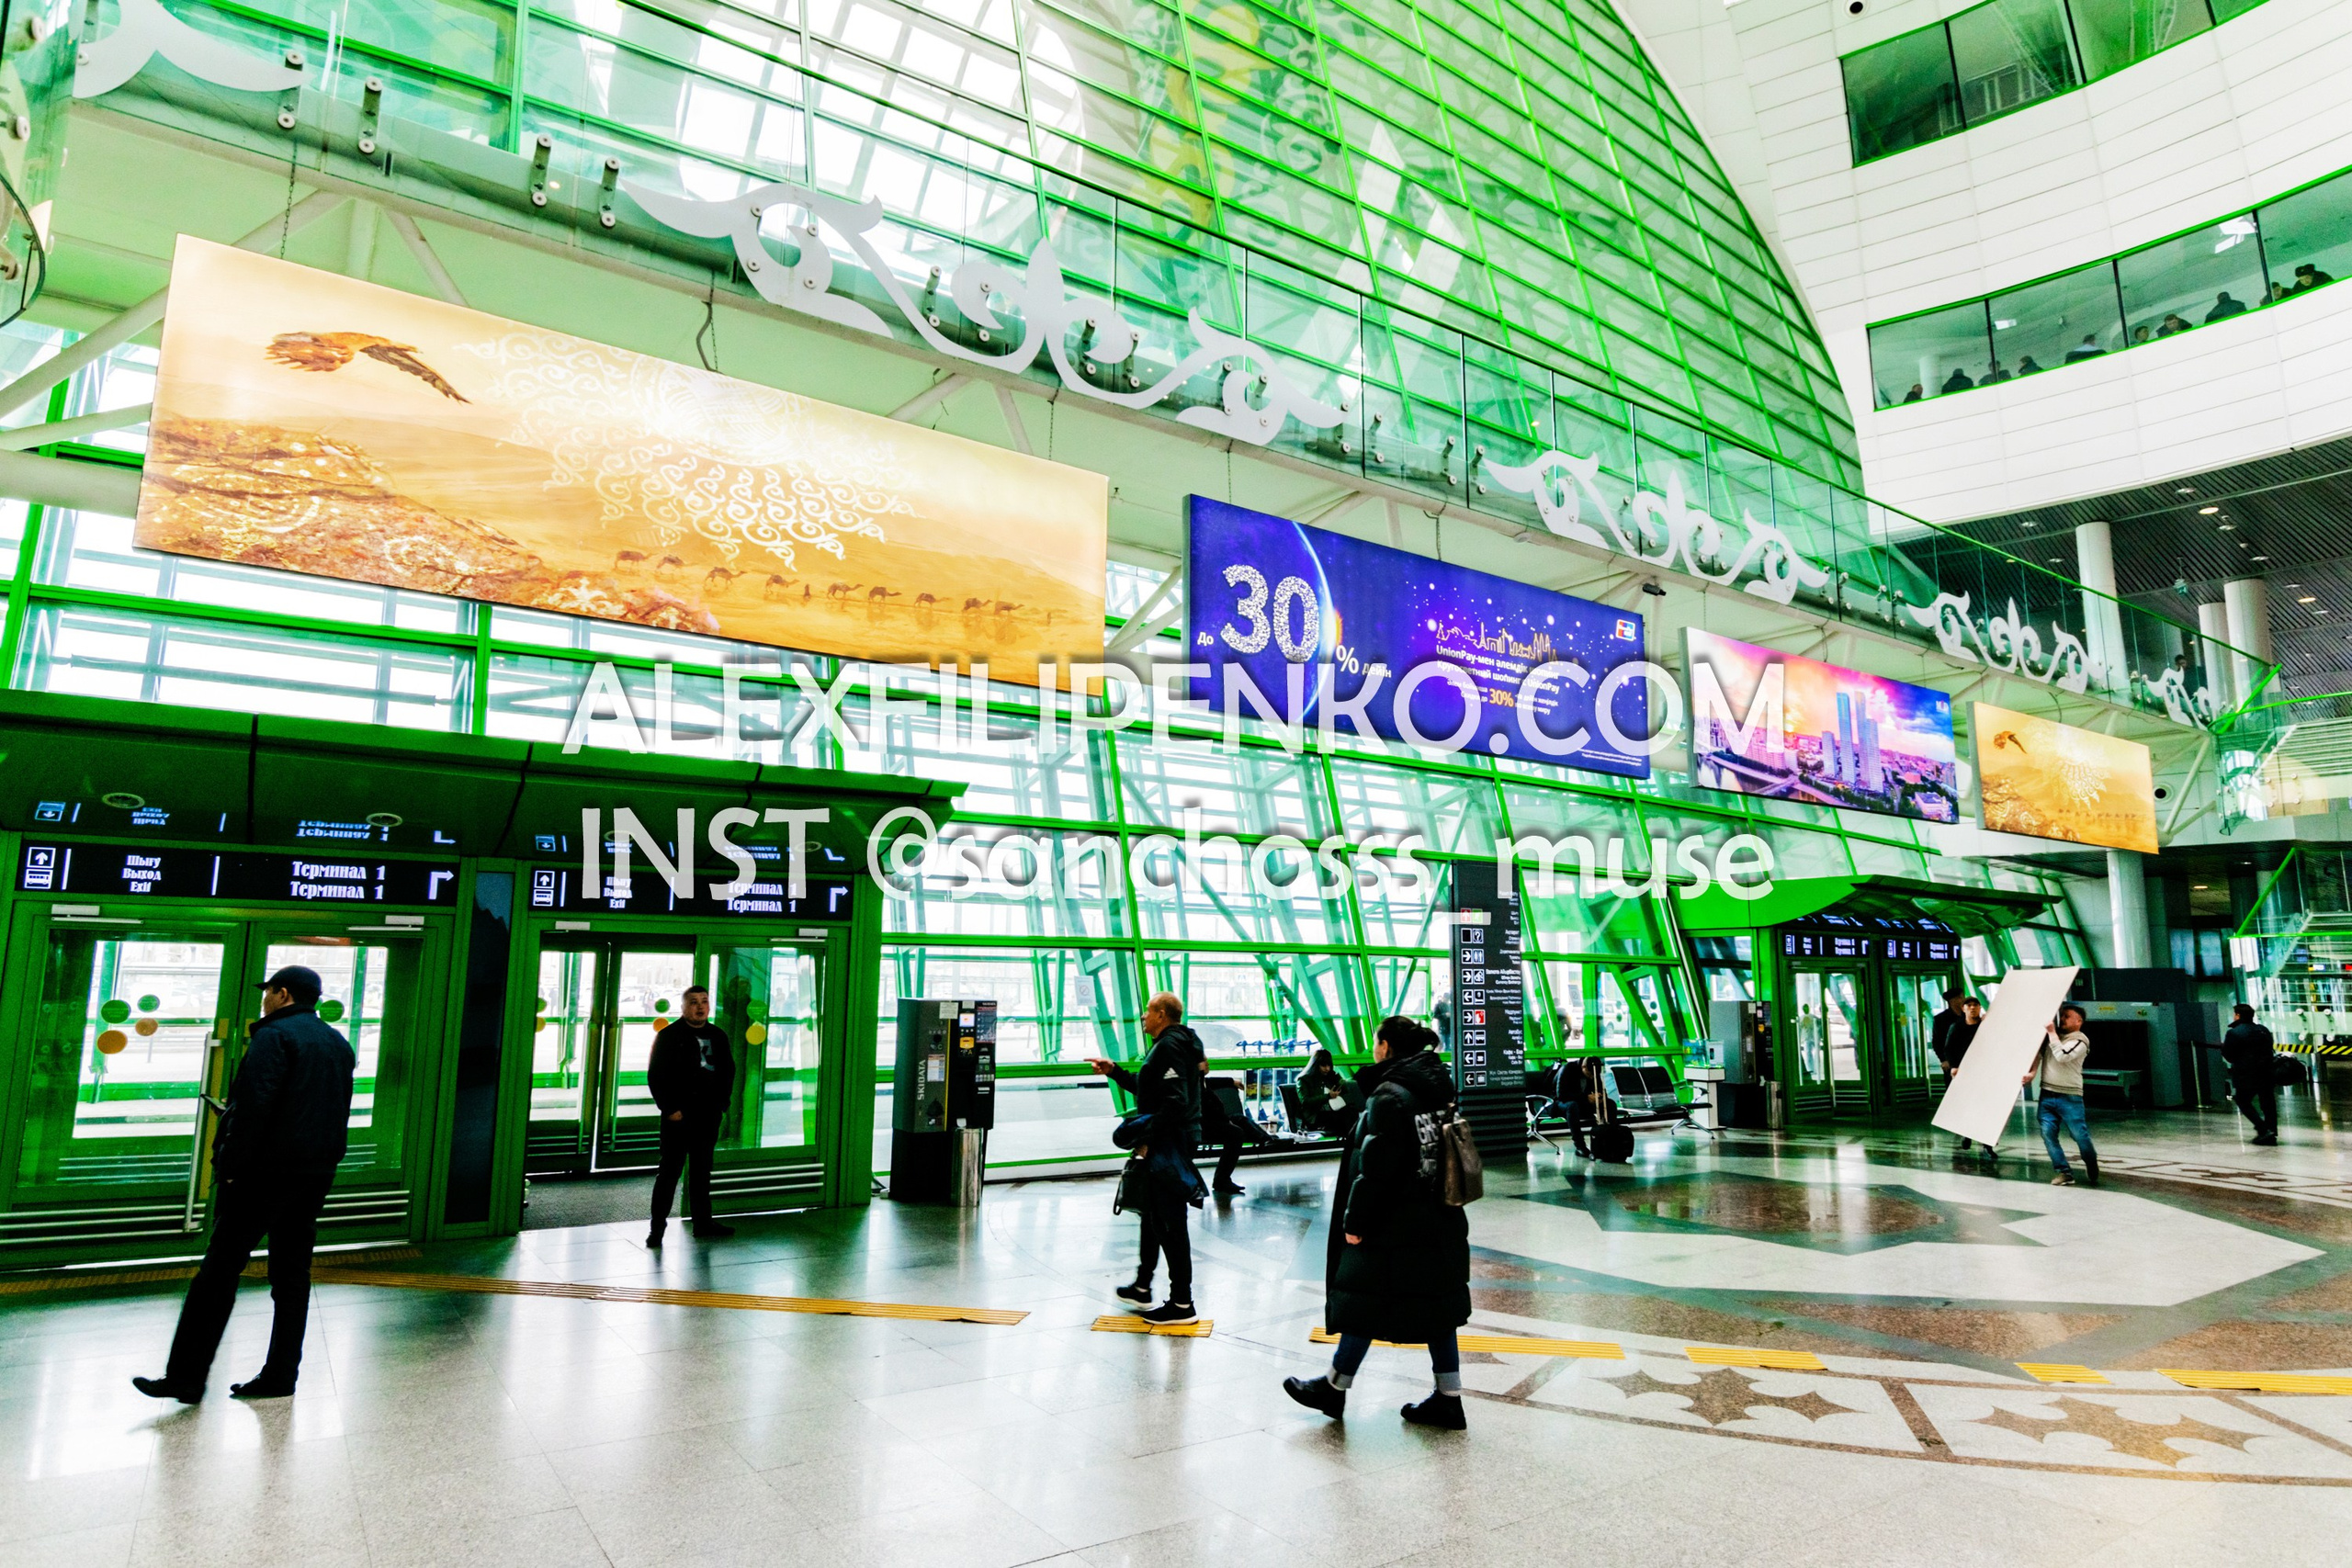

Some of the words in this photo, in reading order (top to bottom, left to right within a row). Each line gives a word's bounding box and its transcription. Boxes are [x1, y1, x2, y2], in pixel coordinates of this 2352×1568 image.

[1196, 631, 1214, 647] До
[1220, 564, 1319, 663] 30
[1489, 688, 1515, 707] 30%
[122, 867, 162, 882] Выход
[292, 861, 367, 880] Терминал
[376, 865, 386, 881] 1
[130, 881, 153, 893] Exit
[289, 880, 365, 899] Терминал
[374, 885, 384, 900] 1
[727, 897, 783, 913] Терминал
[789, 899, 797, 913] 1
[917, 1059, 926, 1100] SKIDATA
